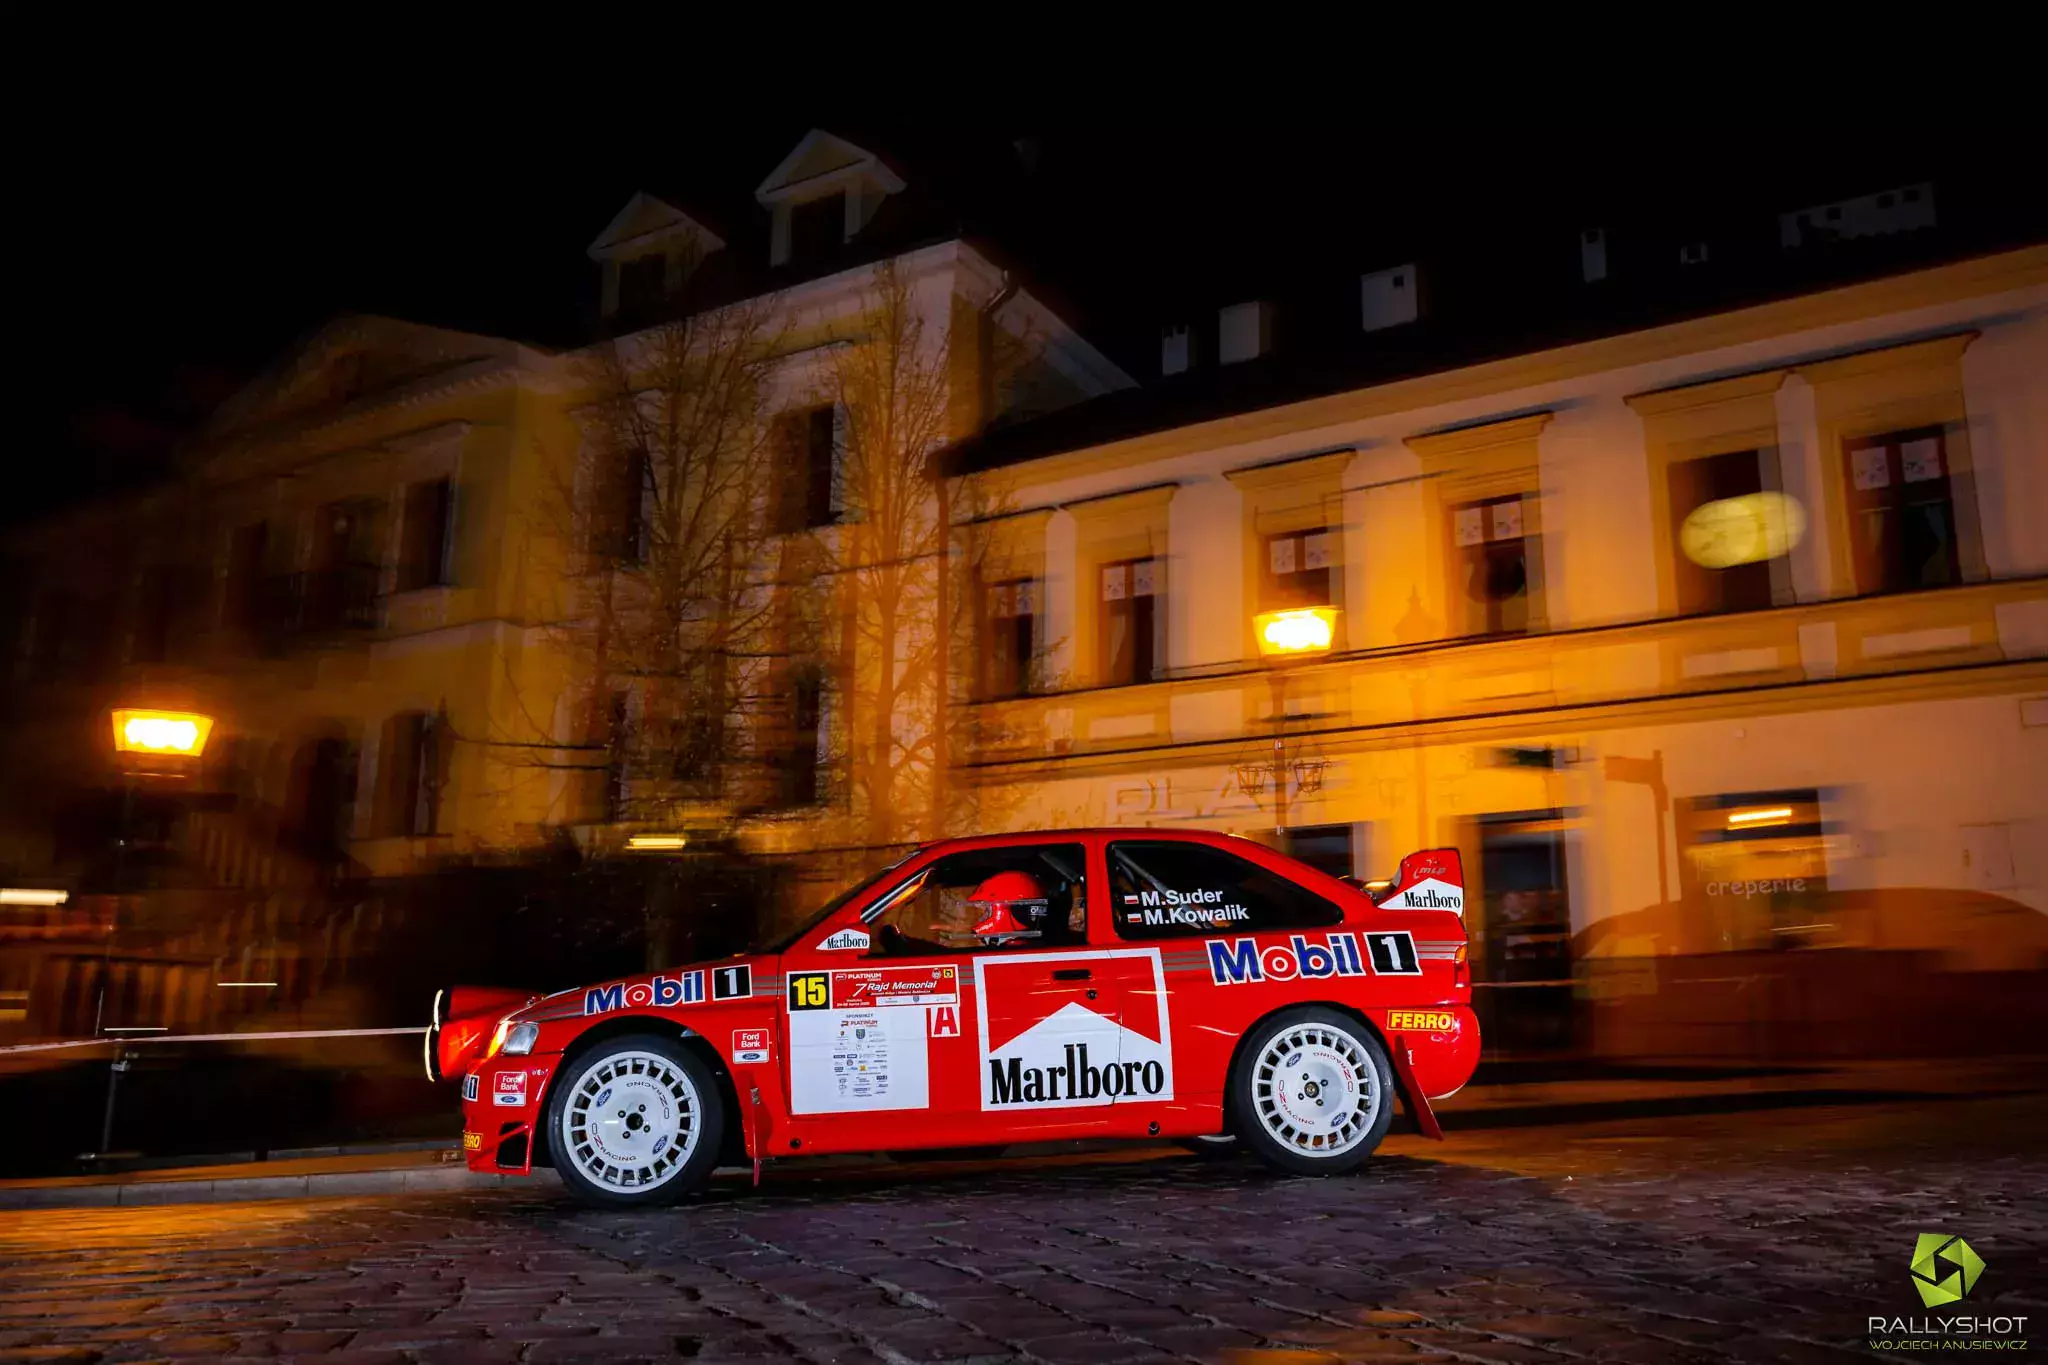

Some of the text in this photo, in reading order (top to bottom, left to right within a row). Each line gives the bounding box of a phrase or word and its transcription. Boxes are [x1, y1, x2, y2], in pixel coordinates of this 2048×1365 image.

[1141, 888, 1224, 907] M.Suder
[1404, 889, 1461, 908] Marlboro
[1706, 878, 1806, 901] creperie
[1144, 904, 1250, 925] M.Kowalik
[827, 933, 868, 949] Marlboro
[1205, 932, 1366, 986] Mobil
[585, 969, 706, 1016] Mobil
[793, 977, 827, 1007] 15
[852, 983, 868, 997] 7
[867, 982, 890, 992] Rajd
[892, 980, 938, 990] Memorial
[934, 1006, 959, 1036] A
[1391, 1012, 1451, 1029] FERRO
[741, 1040, 761, 1048] Bank
[742, 1033, 760, 1041] Ford
[989, 1043, 1165, 1105] Marlboro
[500, 1083, 519, 1091] Bank
